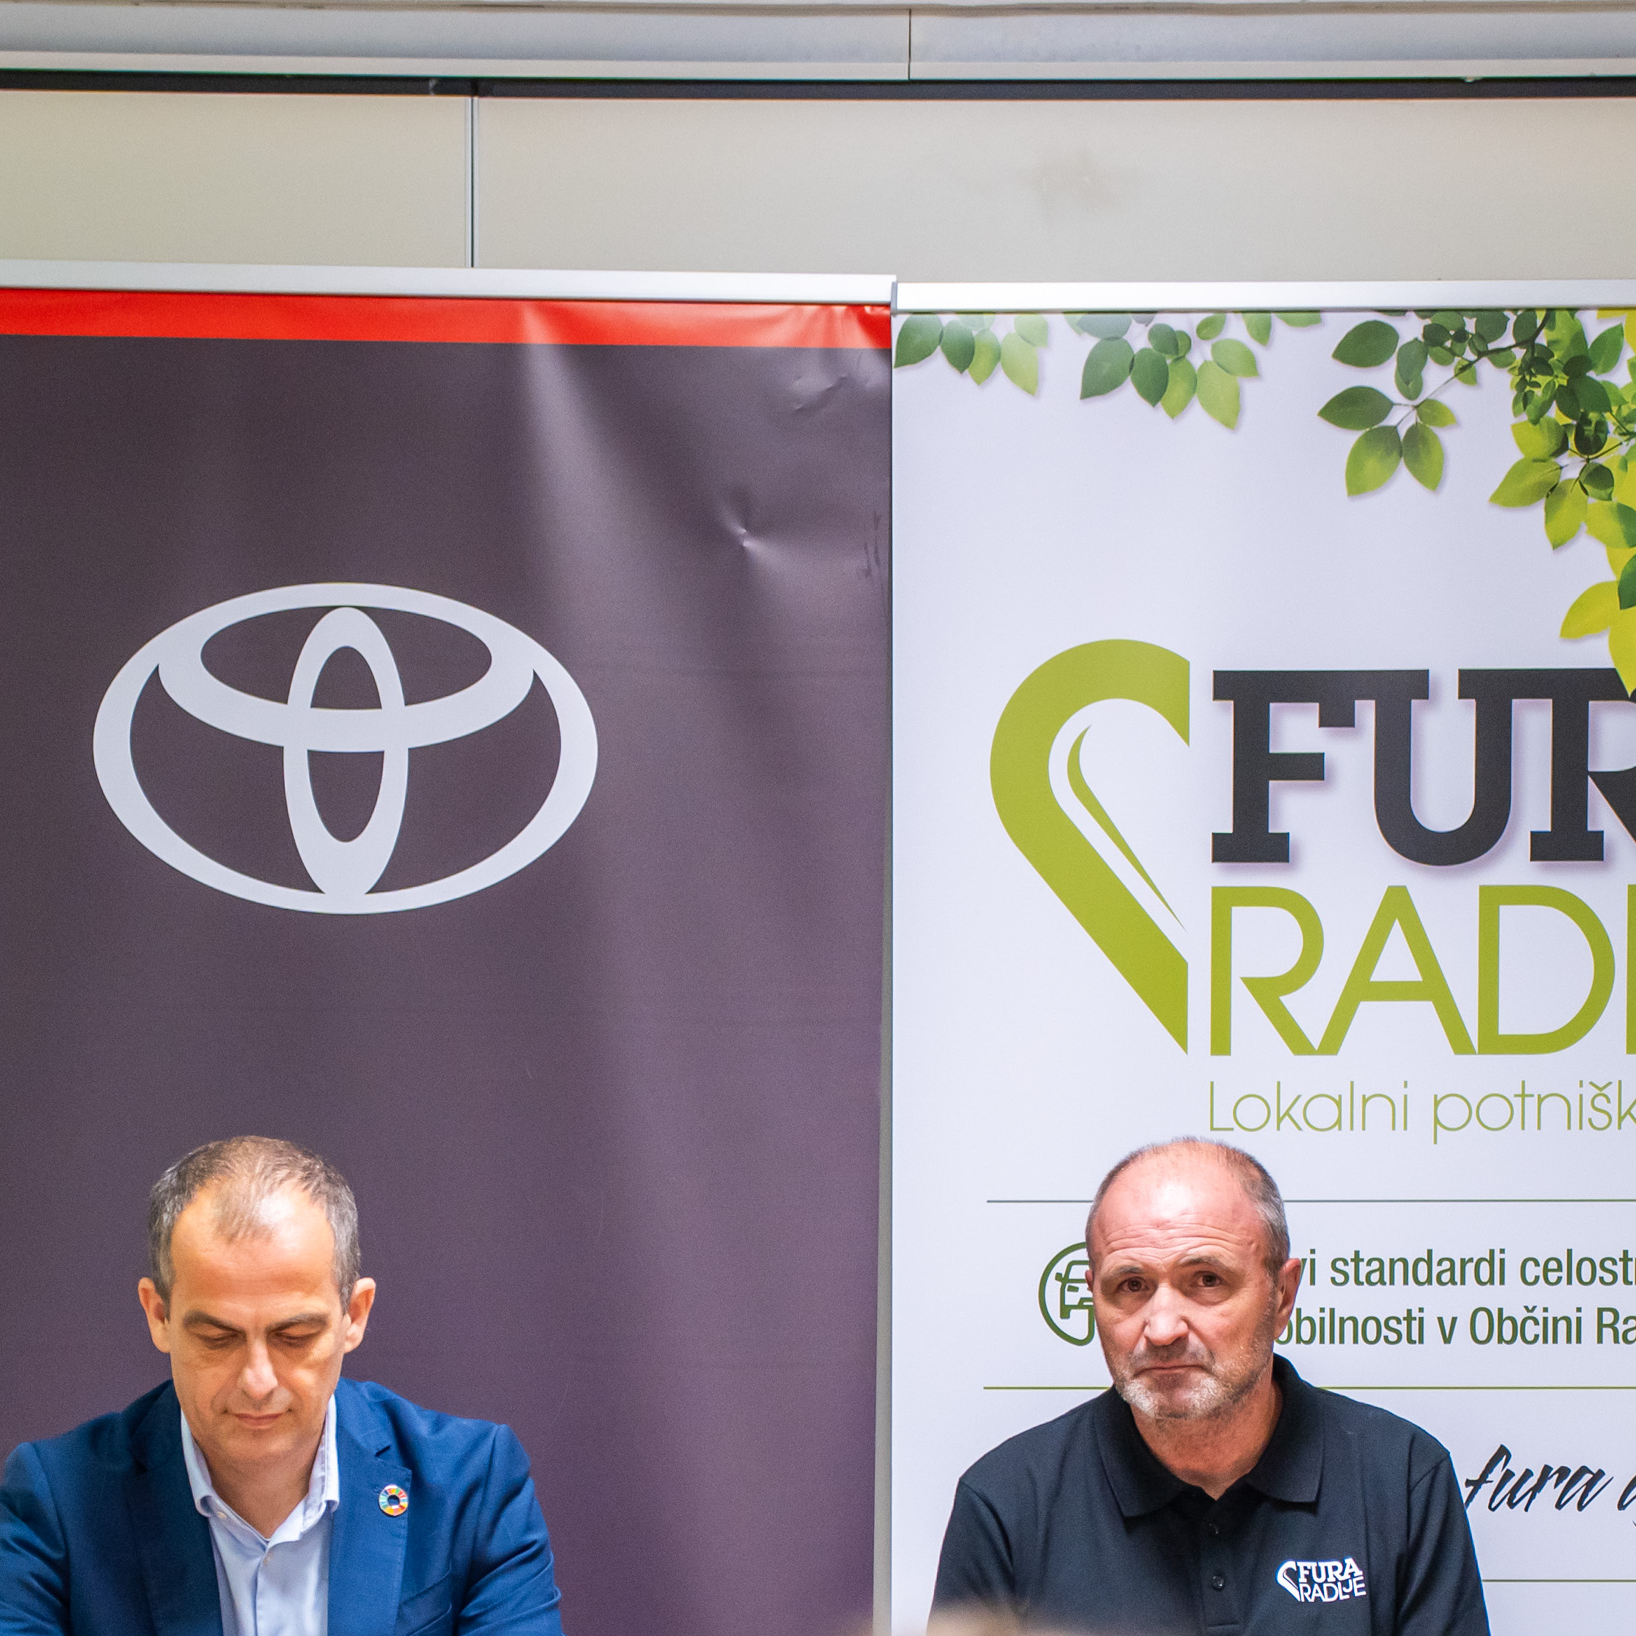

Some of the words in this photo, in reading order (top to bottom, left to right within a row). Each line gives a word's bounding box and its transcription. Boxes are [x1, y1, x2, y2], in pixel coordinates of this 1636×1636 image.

[1209, 1081, 1408, 1133] Lokalni
[1330, 1248, 1506, 1287] standardi
[1275, 1306, 1425, 1346] obilnosti
[1437, 1316, 1458, 1345] v
[1469, 1304, 1583, 1346] Občini
[1297, 1556, 1363, 1583] FURA
[1299, 1575, 1367, 1602] RADLJE
